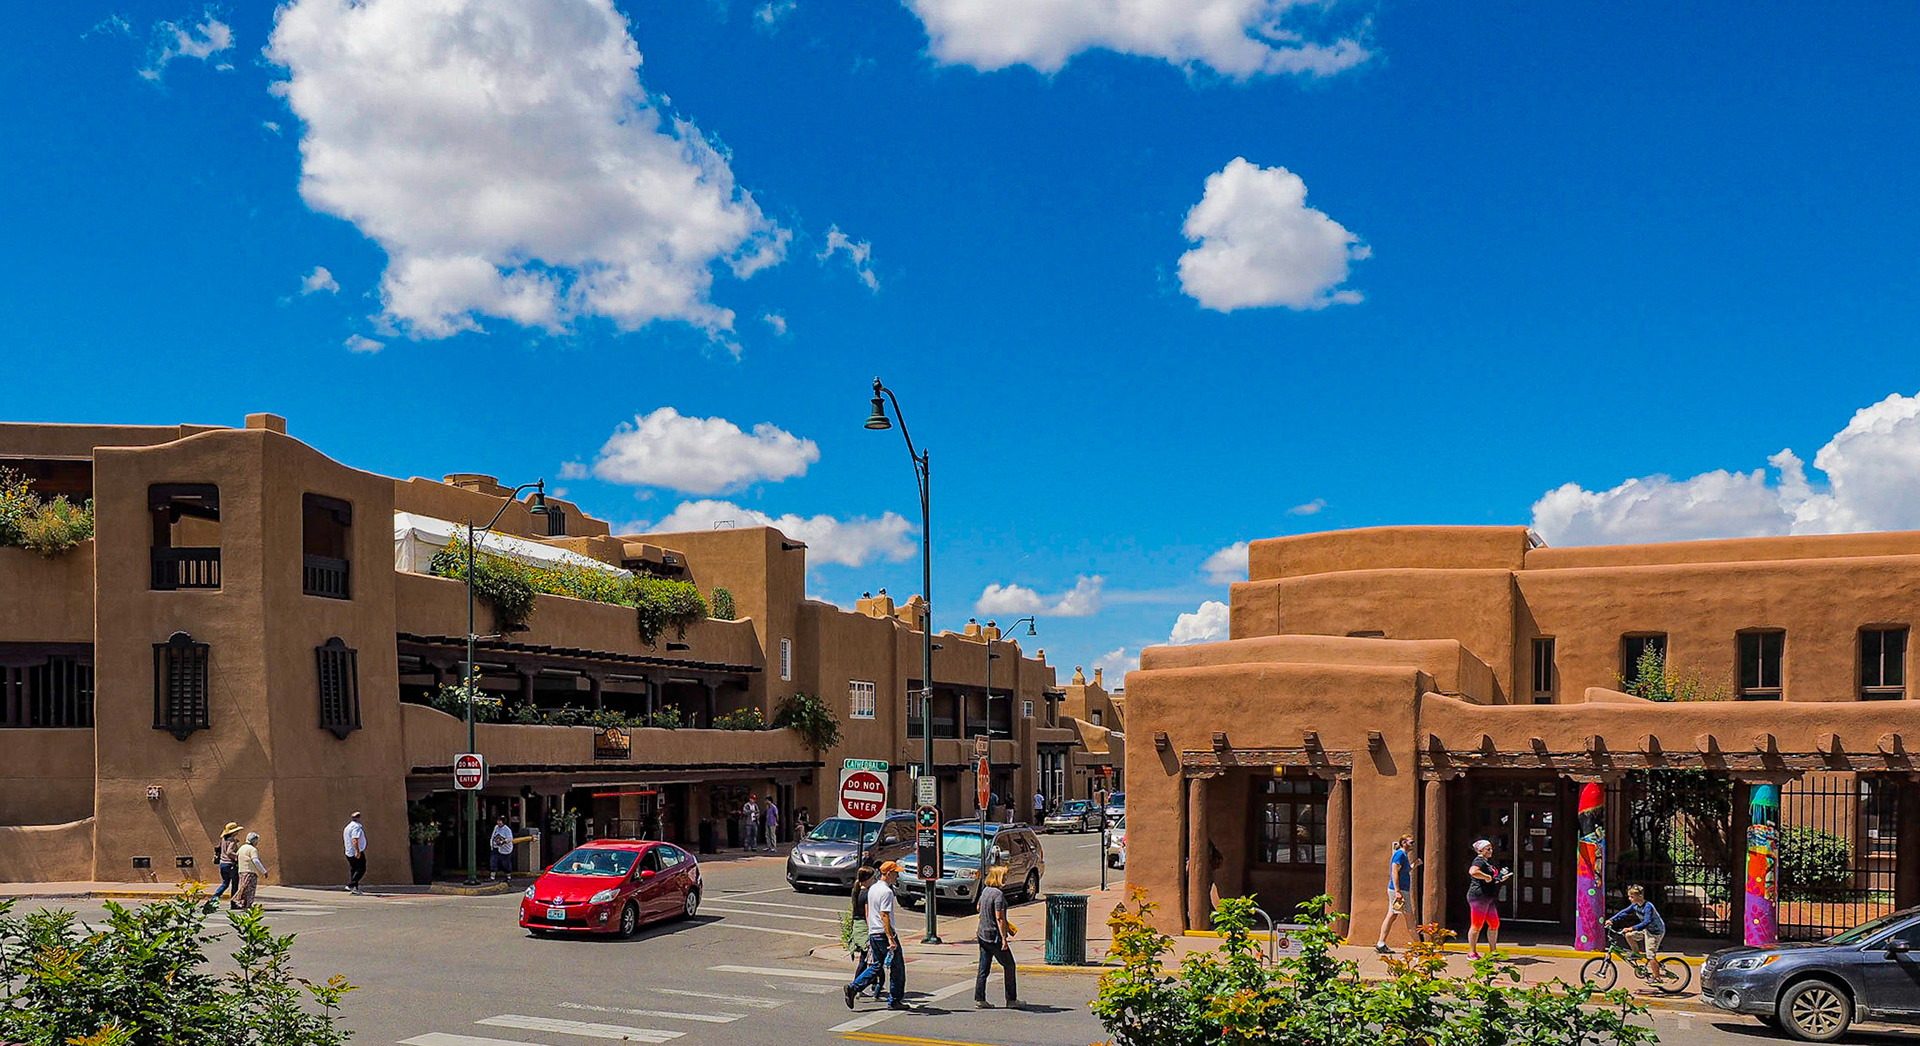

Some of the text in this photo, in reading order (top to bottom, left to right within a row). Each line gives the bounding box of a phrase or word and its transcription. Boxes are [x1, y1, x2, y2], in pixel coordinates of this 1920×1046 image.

[846, 760, 879, 769] CATHEDRAL
[848, 780, 881, 791] DO NOT
[847, 801, 877, 812] ENTER
